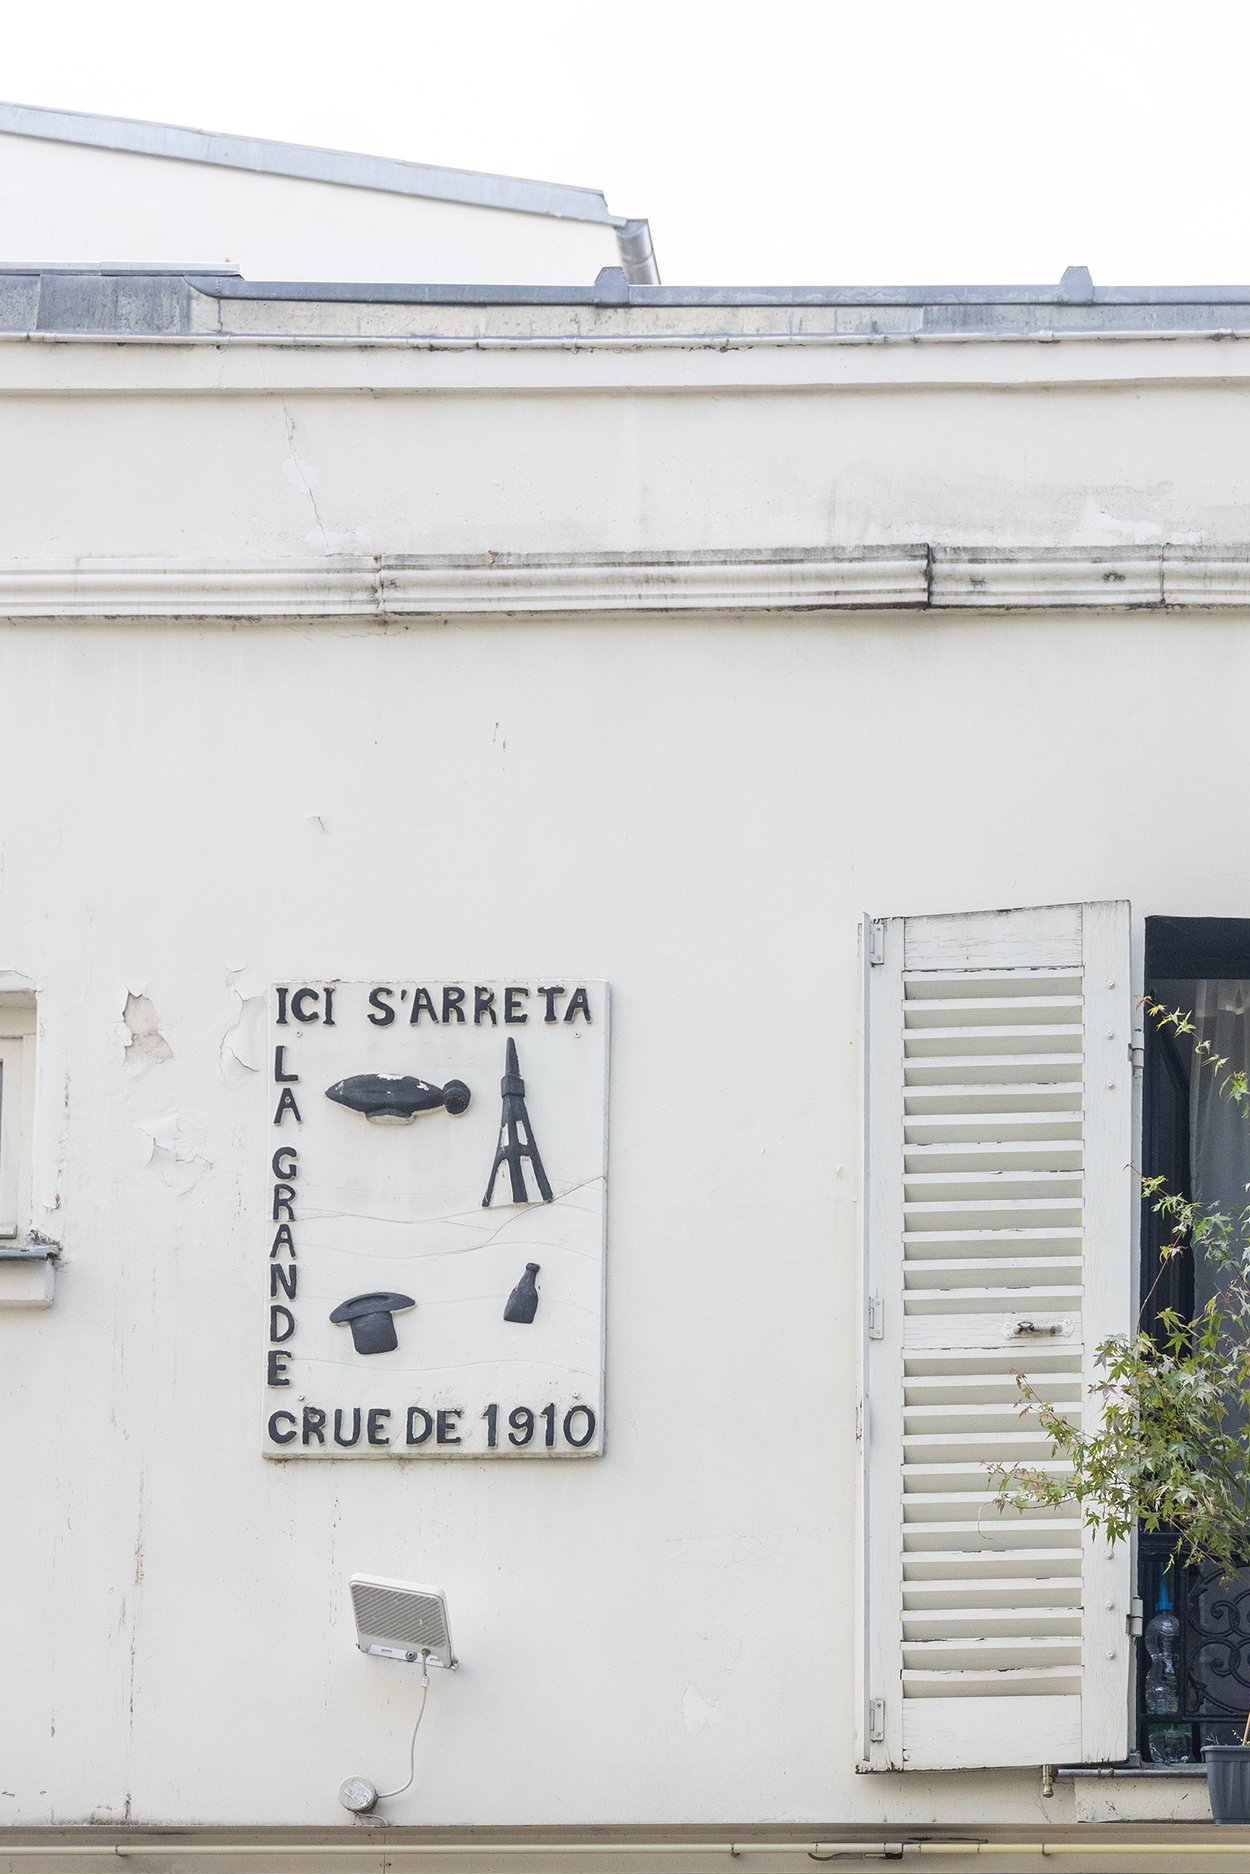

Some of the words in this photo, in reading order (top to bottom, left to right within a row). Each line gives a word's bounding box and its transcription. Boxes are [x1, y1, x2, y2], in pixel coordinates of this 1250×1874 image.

[275, 986, 336, 1026] ICI
[367, 986, 593, 1027] S'ARRETA
[273, 1044, 301, 1125] LA
[267, 1146, 298, 1387] GRANDE
[267, 1406, 391, 1447] CRUE
[406, 1408, 462, 1446] DE
[483, 1402, 597, 1448] 1910
